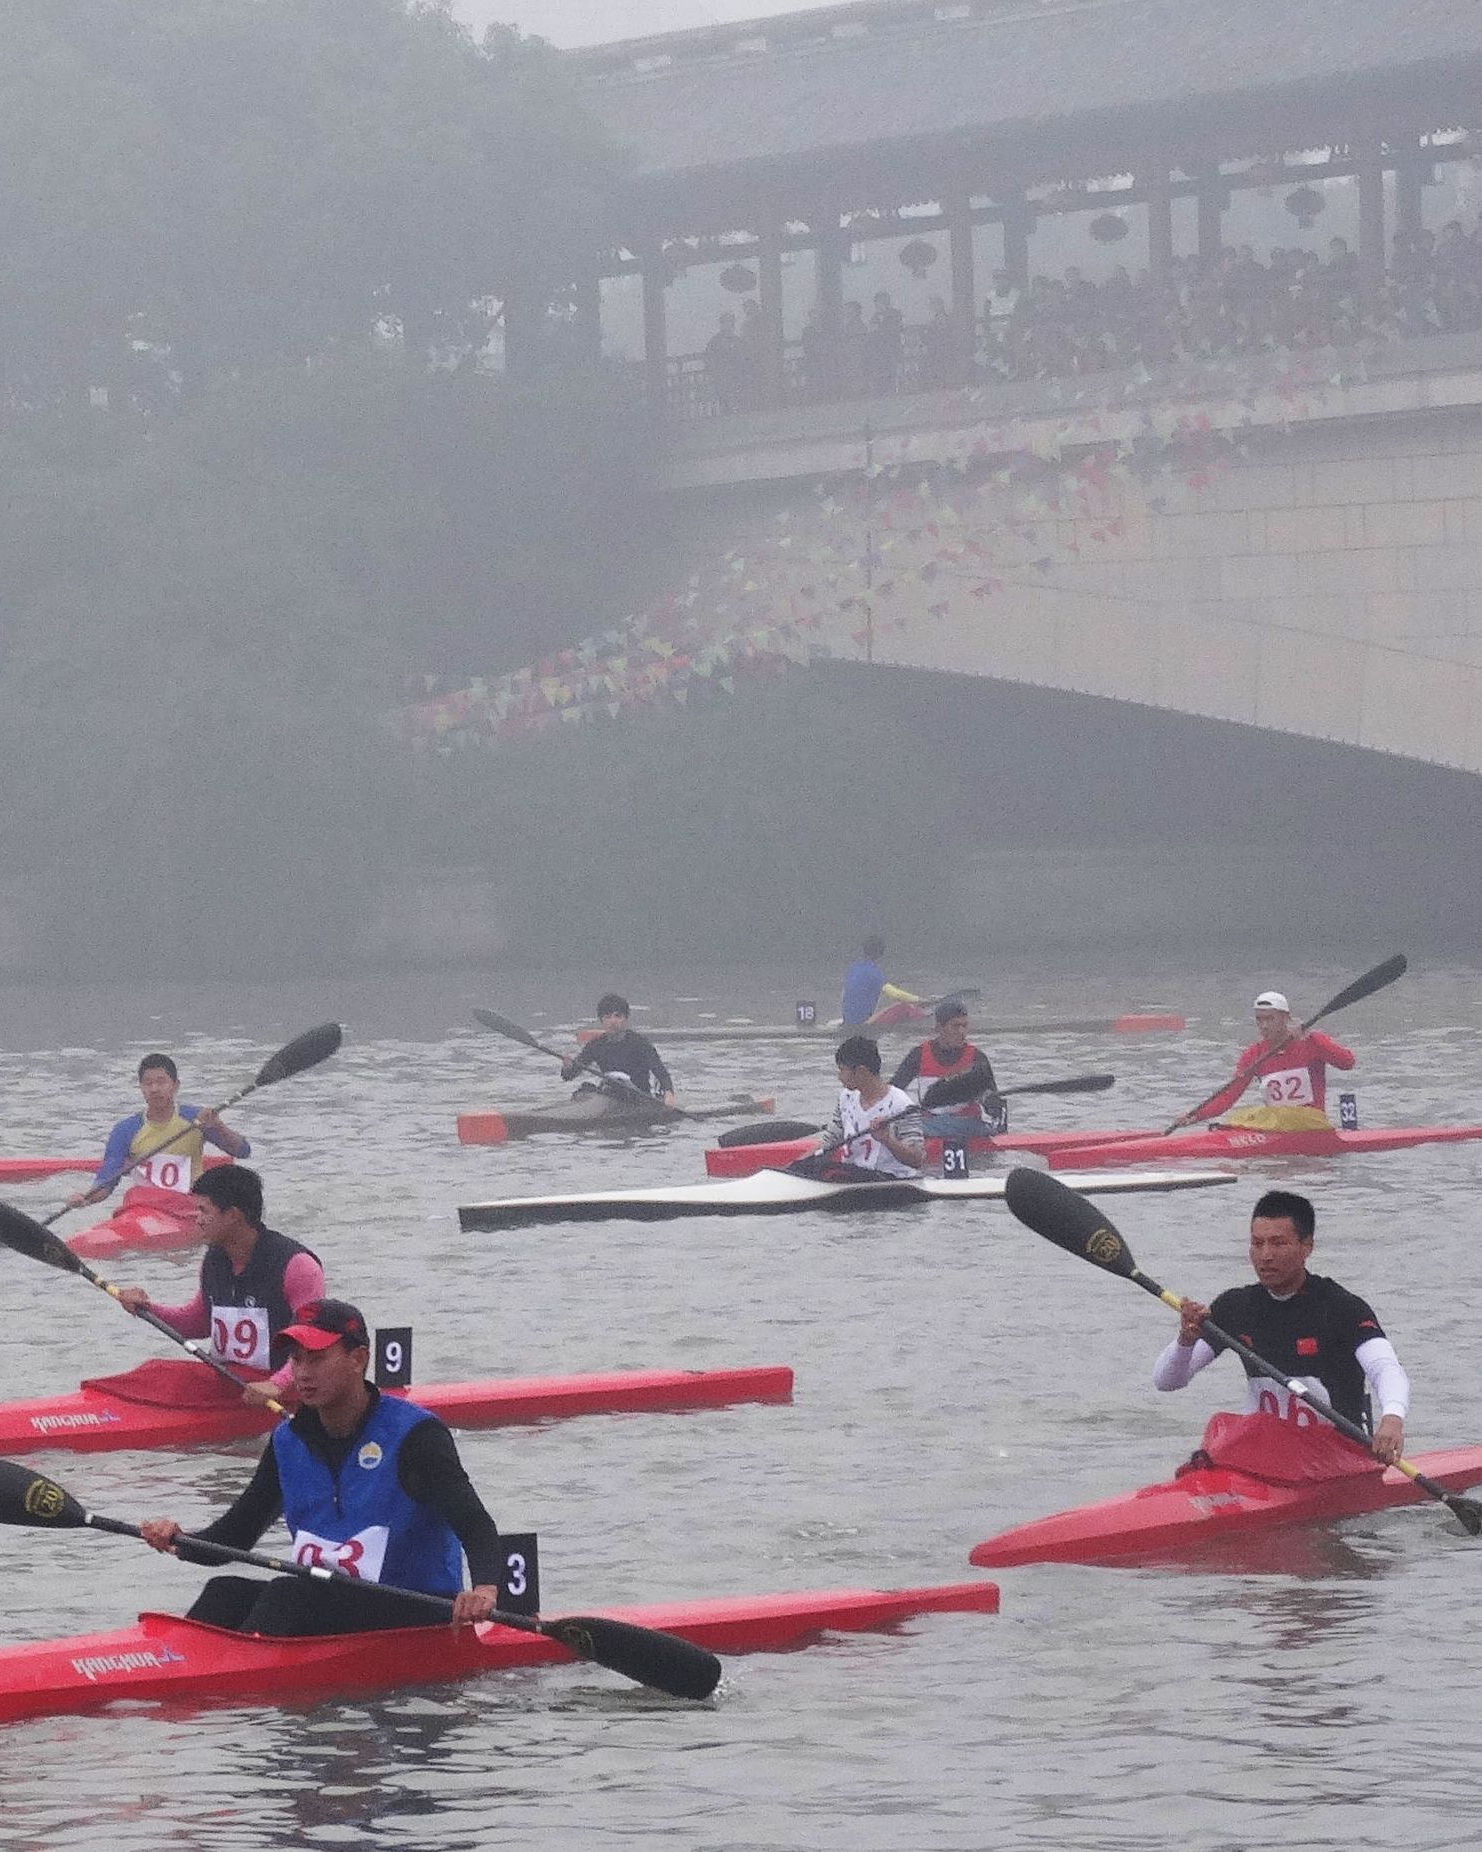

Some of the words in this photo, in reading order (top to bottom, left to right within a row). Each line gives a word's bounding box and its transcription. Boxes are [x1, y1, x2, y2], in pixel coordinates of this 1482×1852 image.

[797, 1006, 815, 1020] 18
[1267, 1076, 1305, 1101] 32
[1341, 1102, 1356, 1121] 32
[944, 1149, 966, 1171] 31
[139, 1161, 179, 1188] 10
[214, 1317, 258, 1359] 09
[385, 1340, 403, 1373] 9
[506, 1552, 527, 1596] 3
